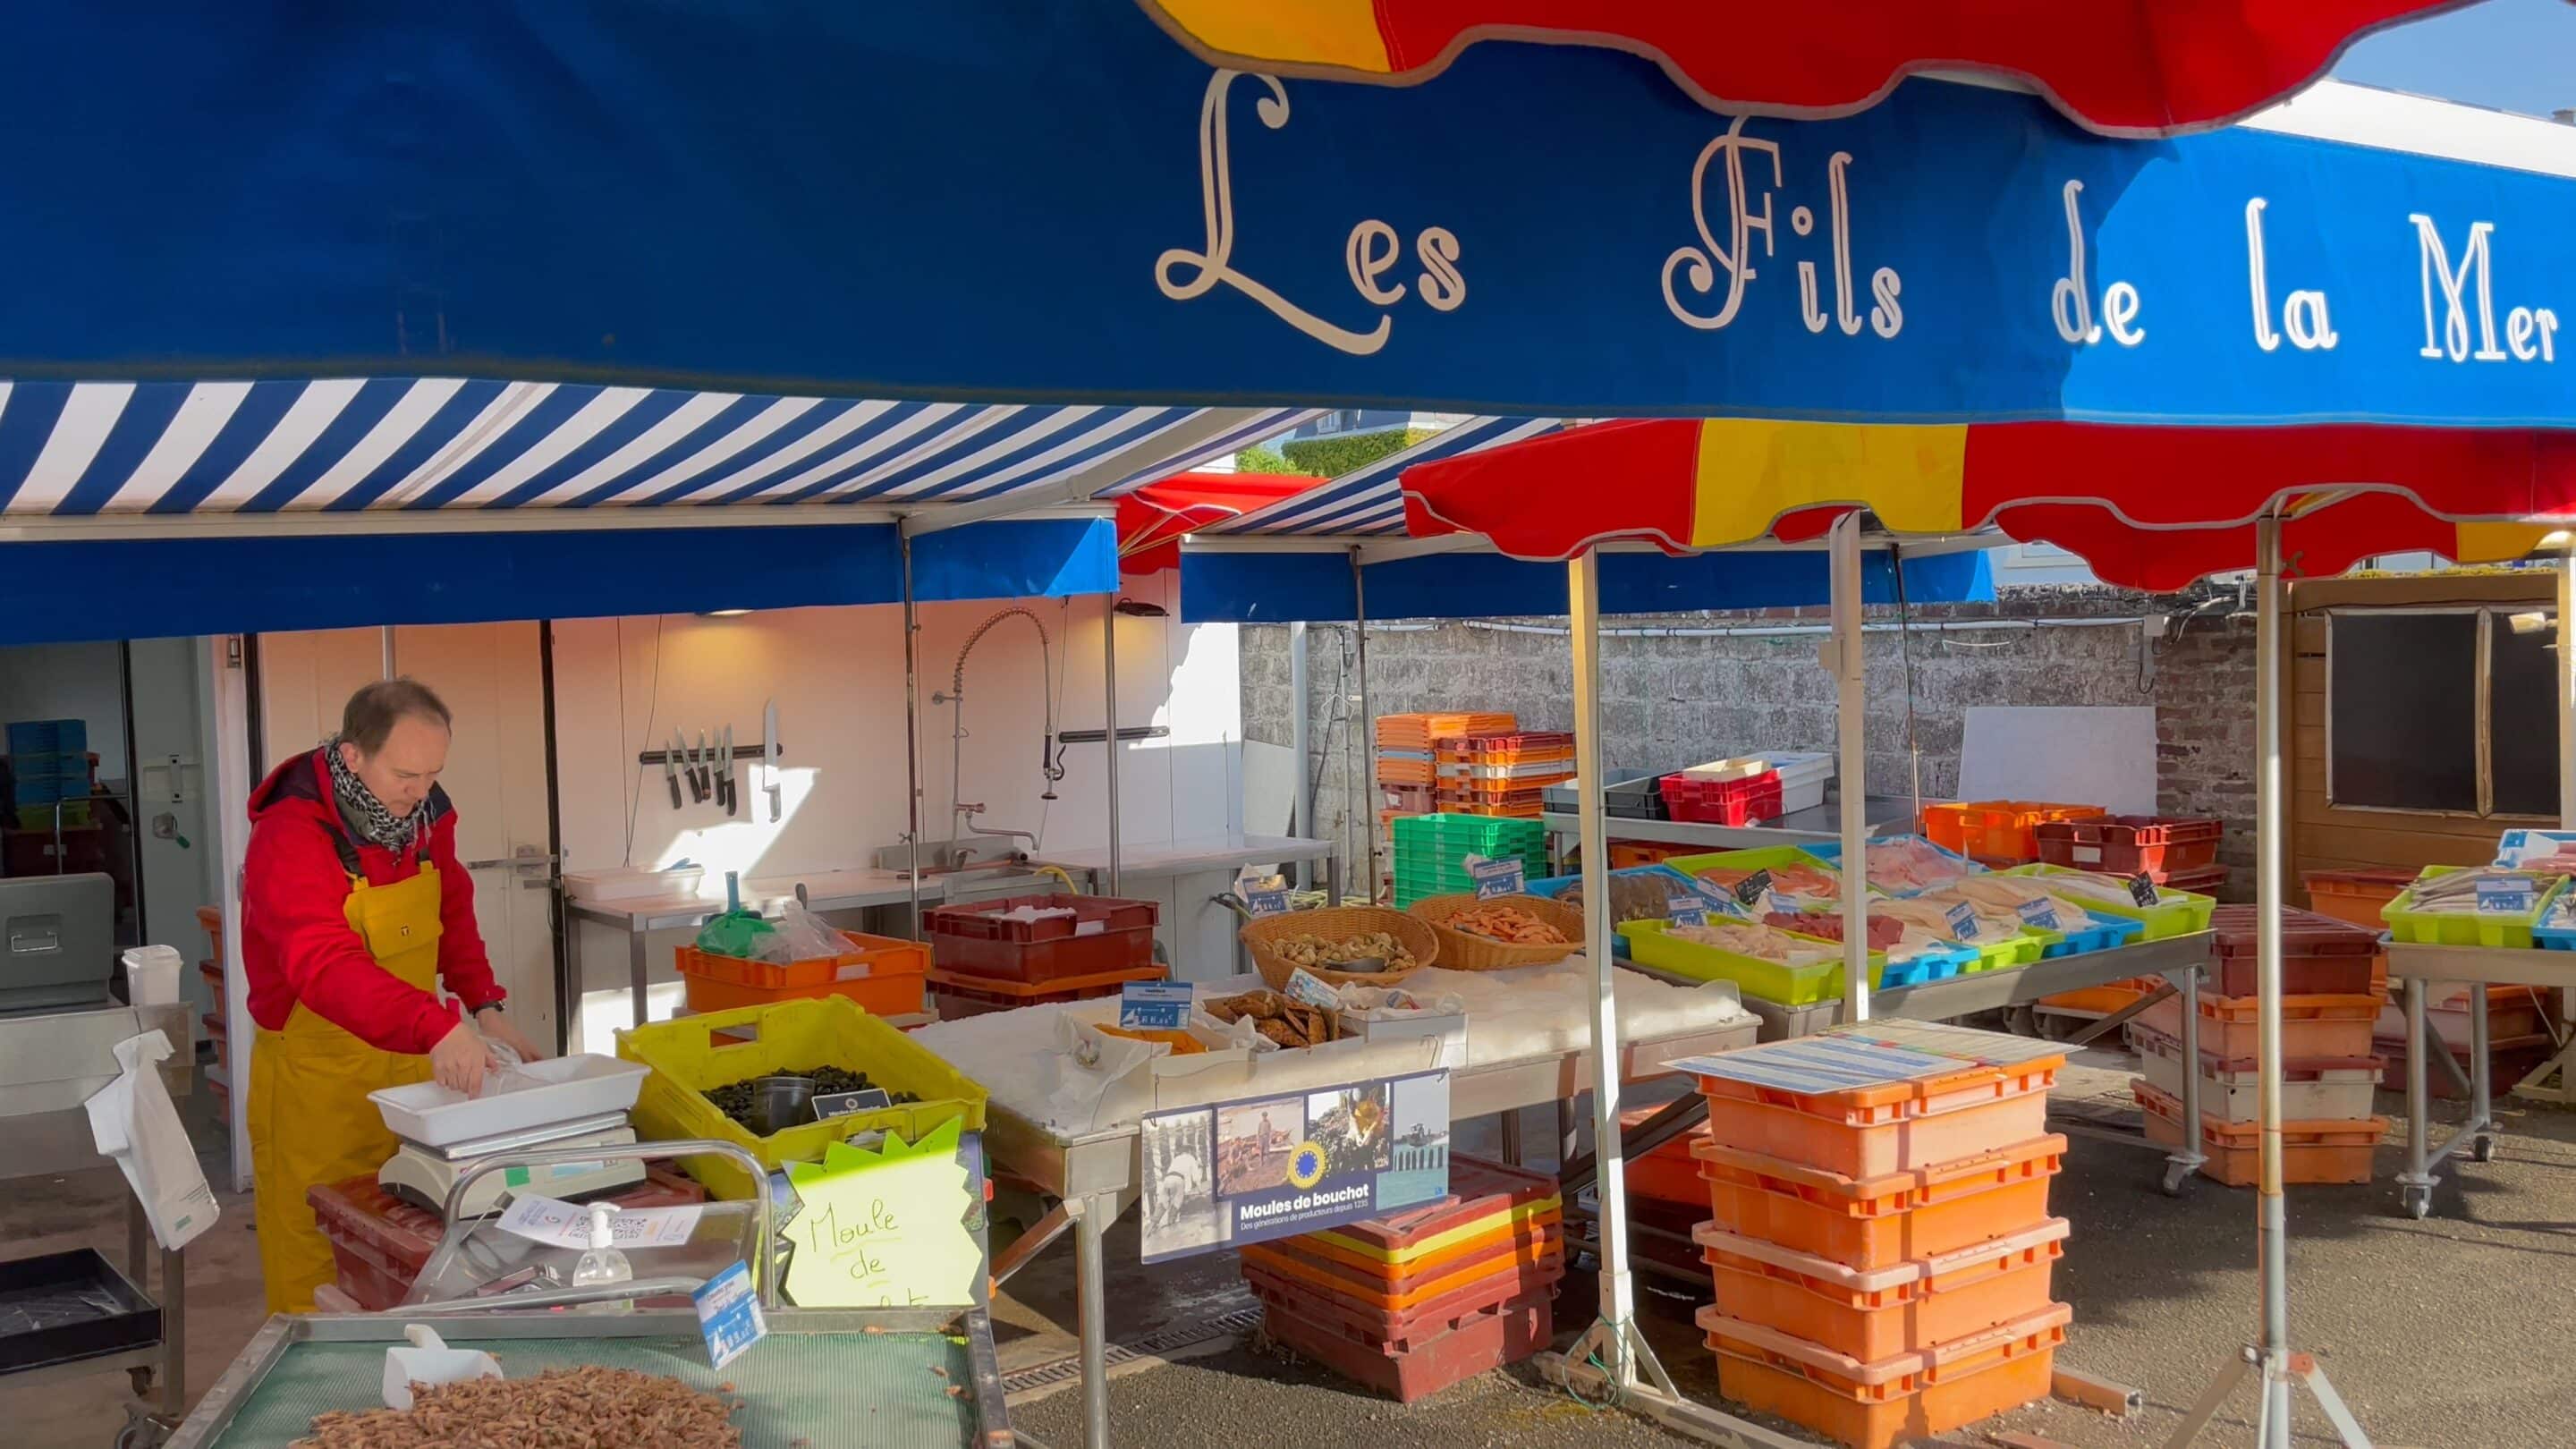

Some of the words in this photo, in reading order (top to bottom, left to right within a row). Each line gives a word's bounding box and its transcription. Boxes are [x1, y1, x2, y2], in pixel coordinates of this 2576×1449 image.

[1154, 68, 1466, 355] Les
[1661, 115, 1903, 339] Fils
[2052, 179, 2145, 345] de
[2245, 197, 2338, 352] la
[2409, 213, 2558, 363] Mer
[1240, 1199, 1292, 1221] Moules
[1293, 1195, 1311, 1210] de
[1312, 1183, 1369, 1207] bouchot
[1240, 1220, 1253, 1232] Des
[1289, 1212, 1298, 1222] de
[1298, 1206, 1334, 1219] producteurs
[1334, 1201, 1353, 1215] depuis
[809, 1199, 899, 1253] Moule
[850, 1249, 886, 1280] de
